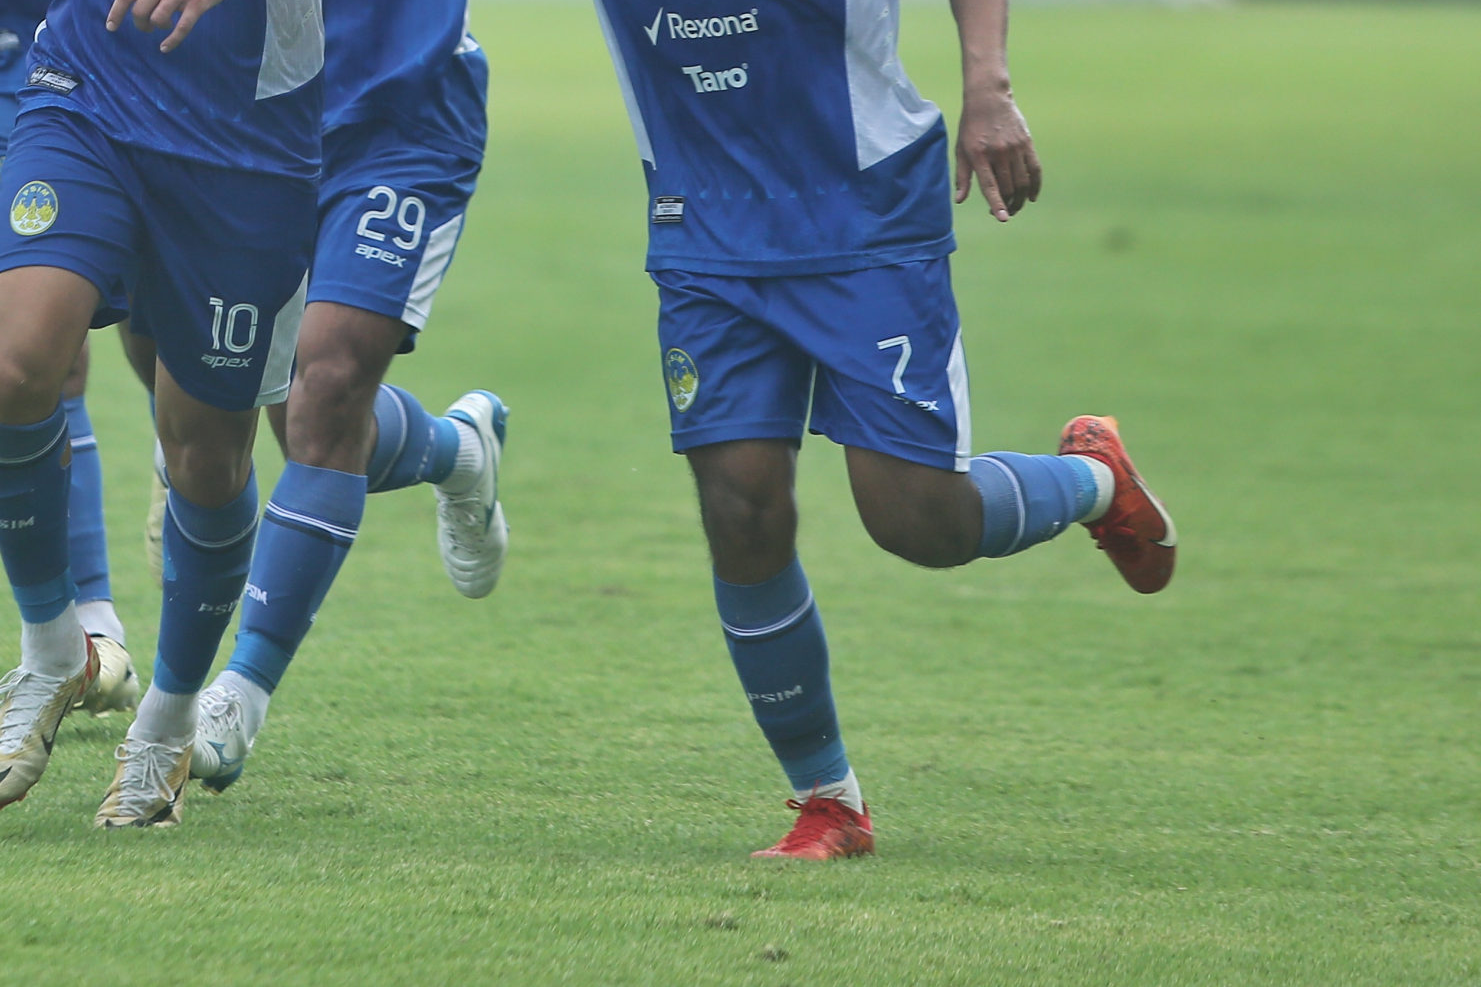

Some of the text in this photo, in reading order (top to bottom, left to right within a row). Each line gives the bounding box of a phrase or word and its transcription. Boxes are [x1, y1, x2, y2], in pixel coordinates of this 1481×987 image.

[667, 10, 759, 40] Rexona
[683, 63, 748, 94] Taro
[356, 185, 426, 251] 29
[354, 243, 408, 268] apex
[209, 296, 259, 353] 10
[201, 353, 253, 369] apex
[877, 335, 912, 394] 7
